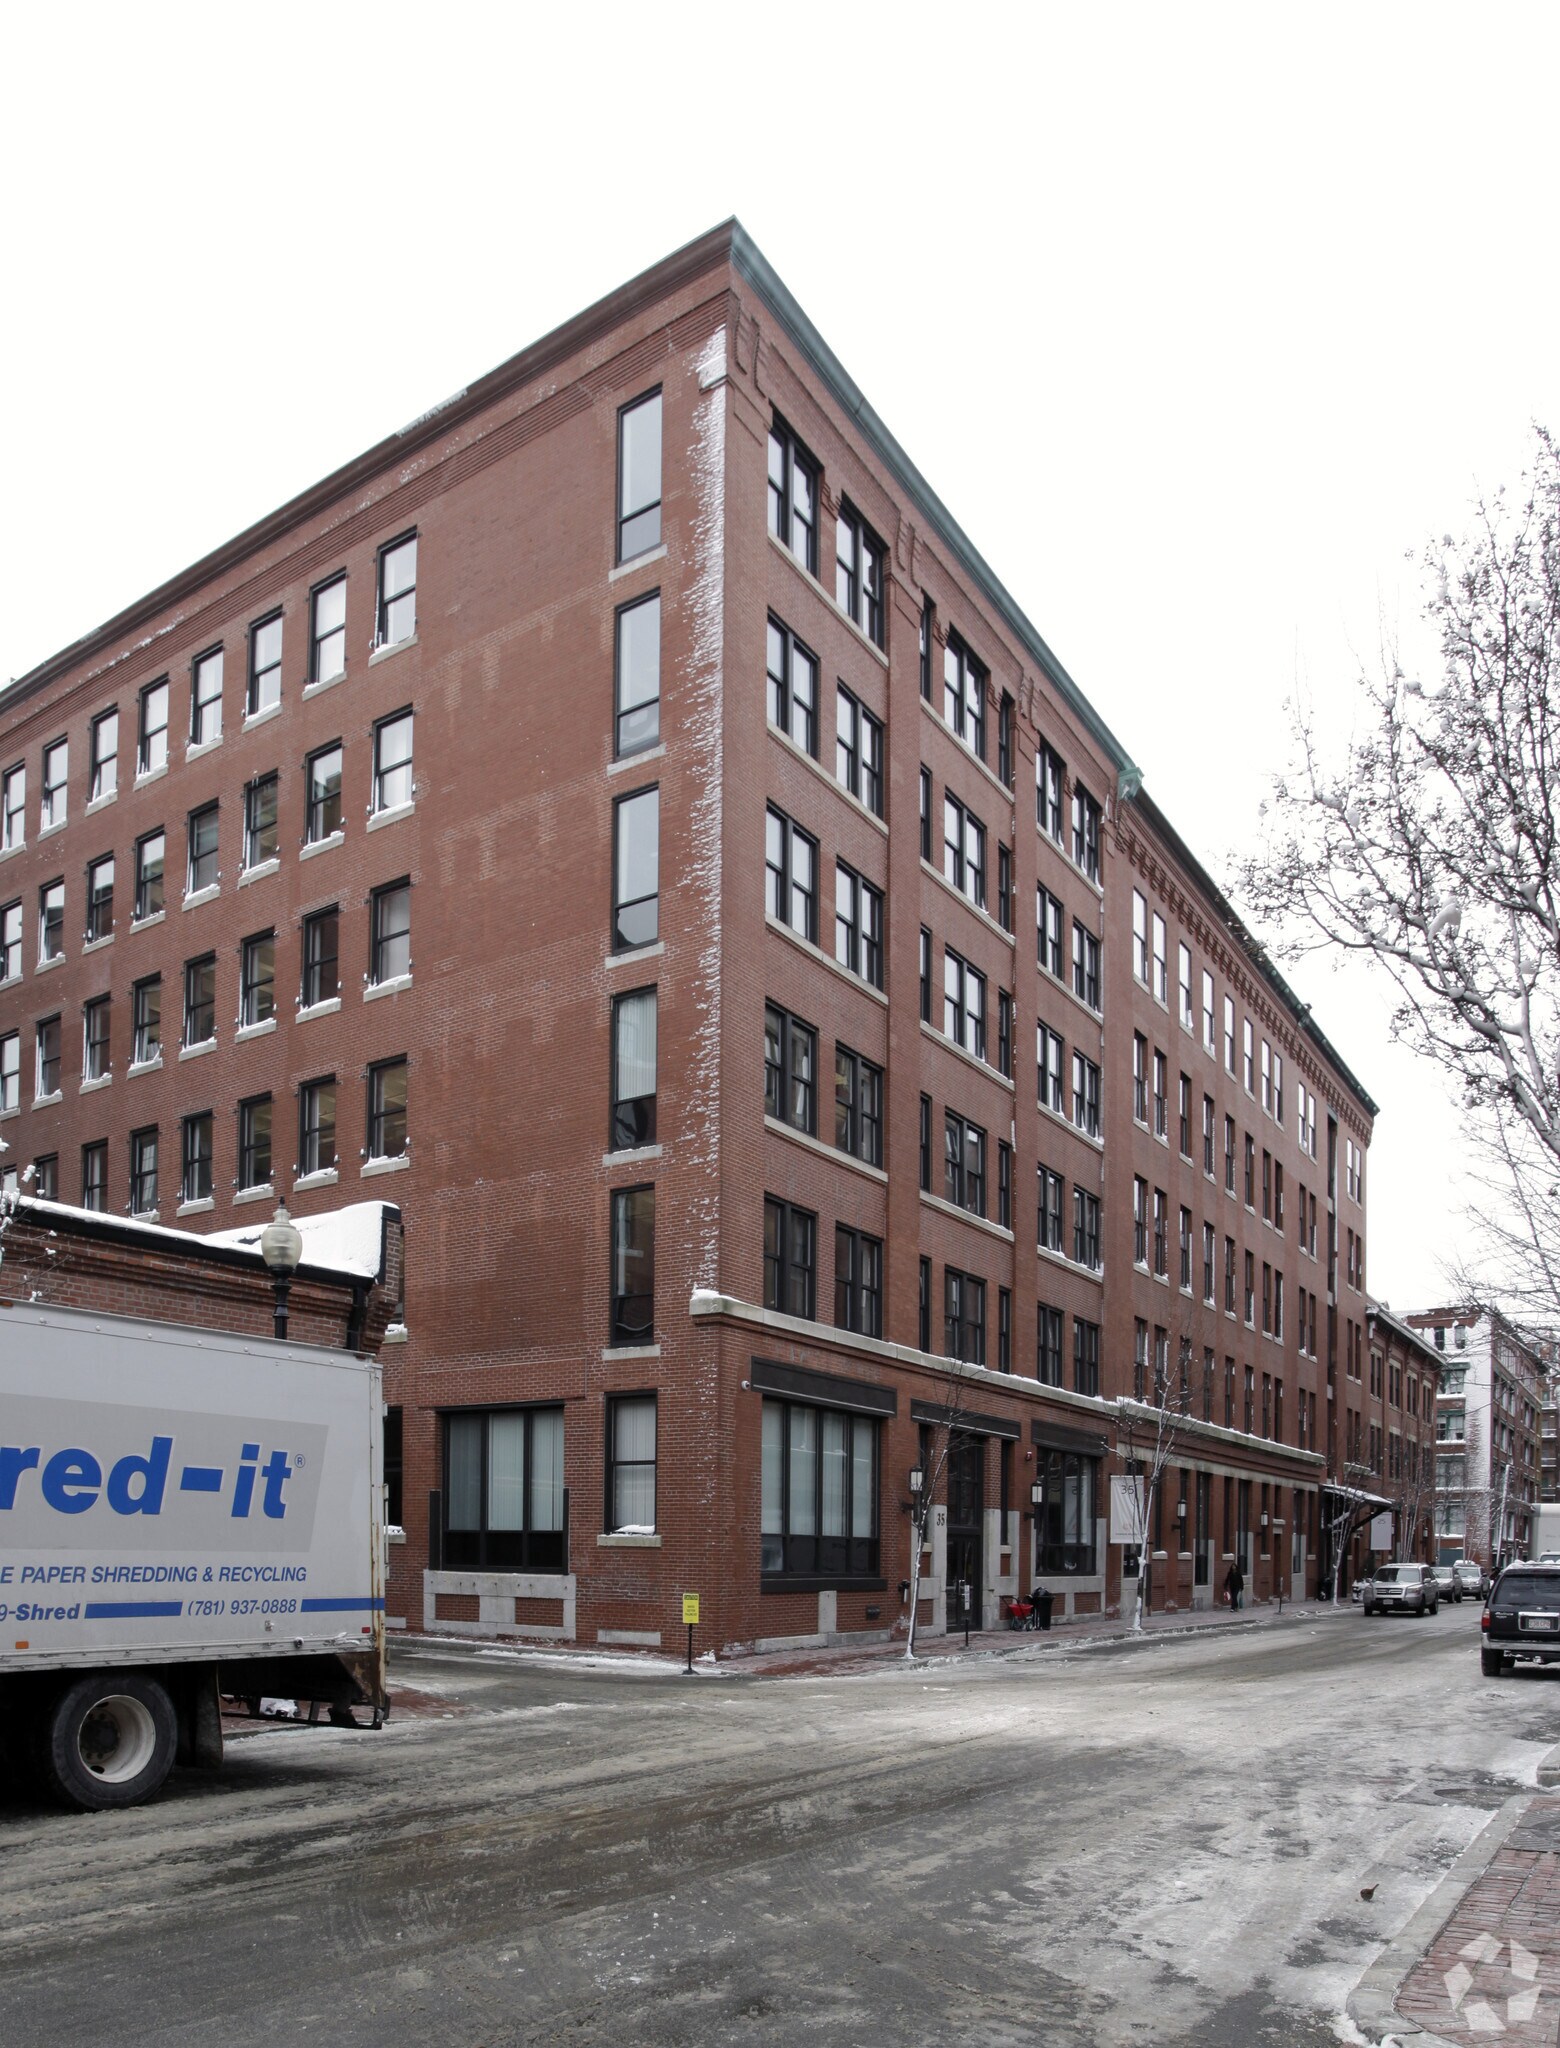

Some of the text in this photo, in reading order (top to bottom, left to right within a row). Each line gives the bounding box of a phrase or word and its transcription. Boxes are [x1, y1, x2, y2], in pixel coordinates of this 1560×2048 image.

[936, 1512, 945, 1527] 35
[21, 1566, 86, 1583] PAPER
[91, 1566, 198, 1583] SHREDDING
[202, 1567, 213, 1582] &
[218, 1567, 307, 1582] RECYCLING
[187, 1600, 225, 1617] (781)
[230, 1599, 297, 1615] 937-0888
